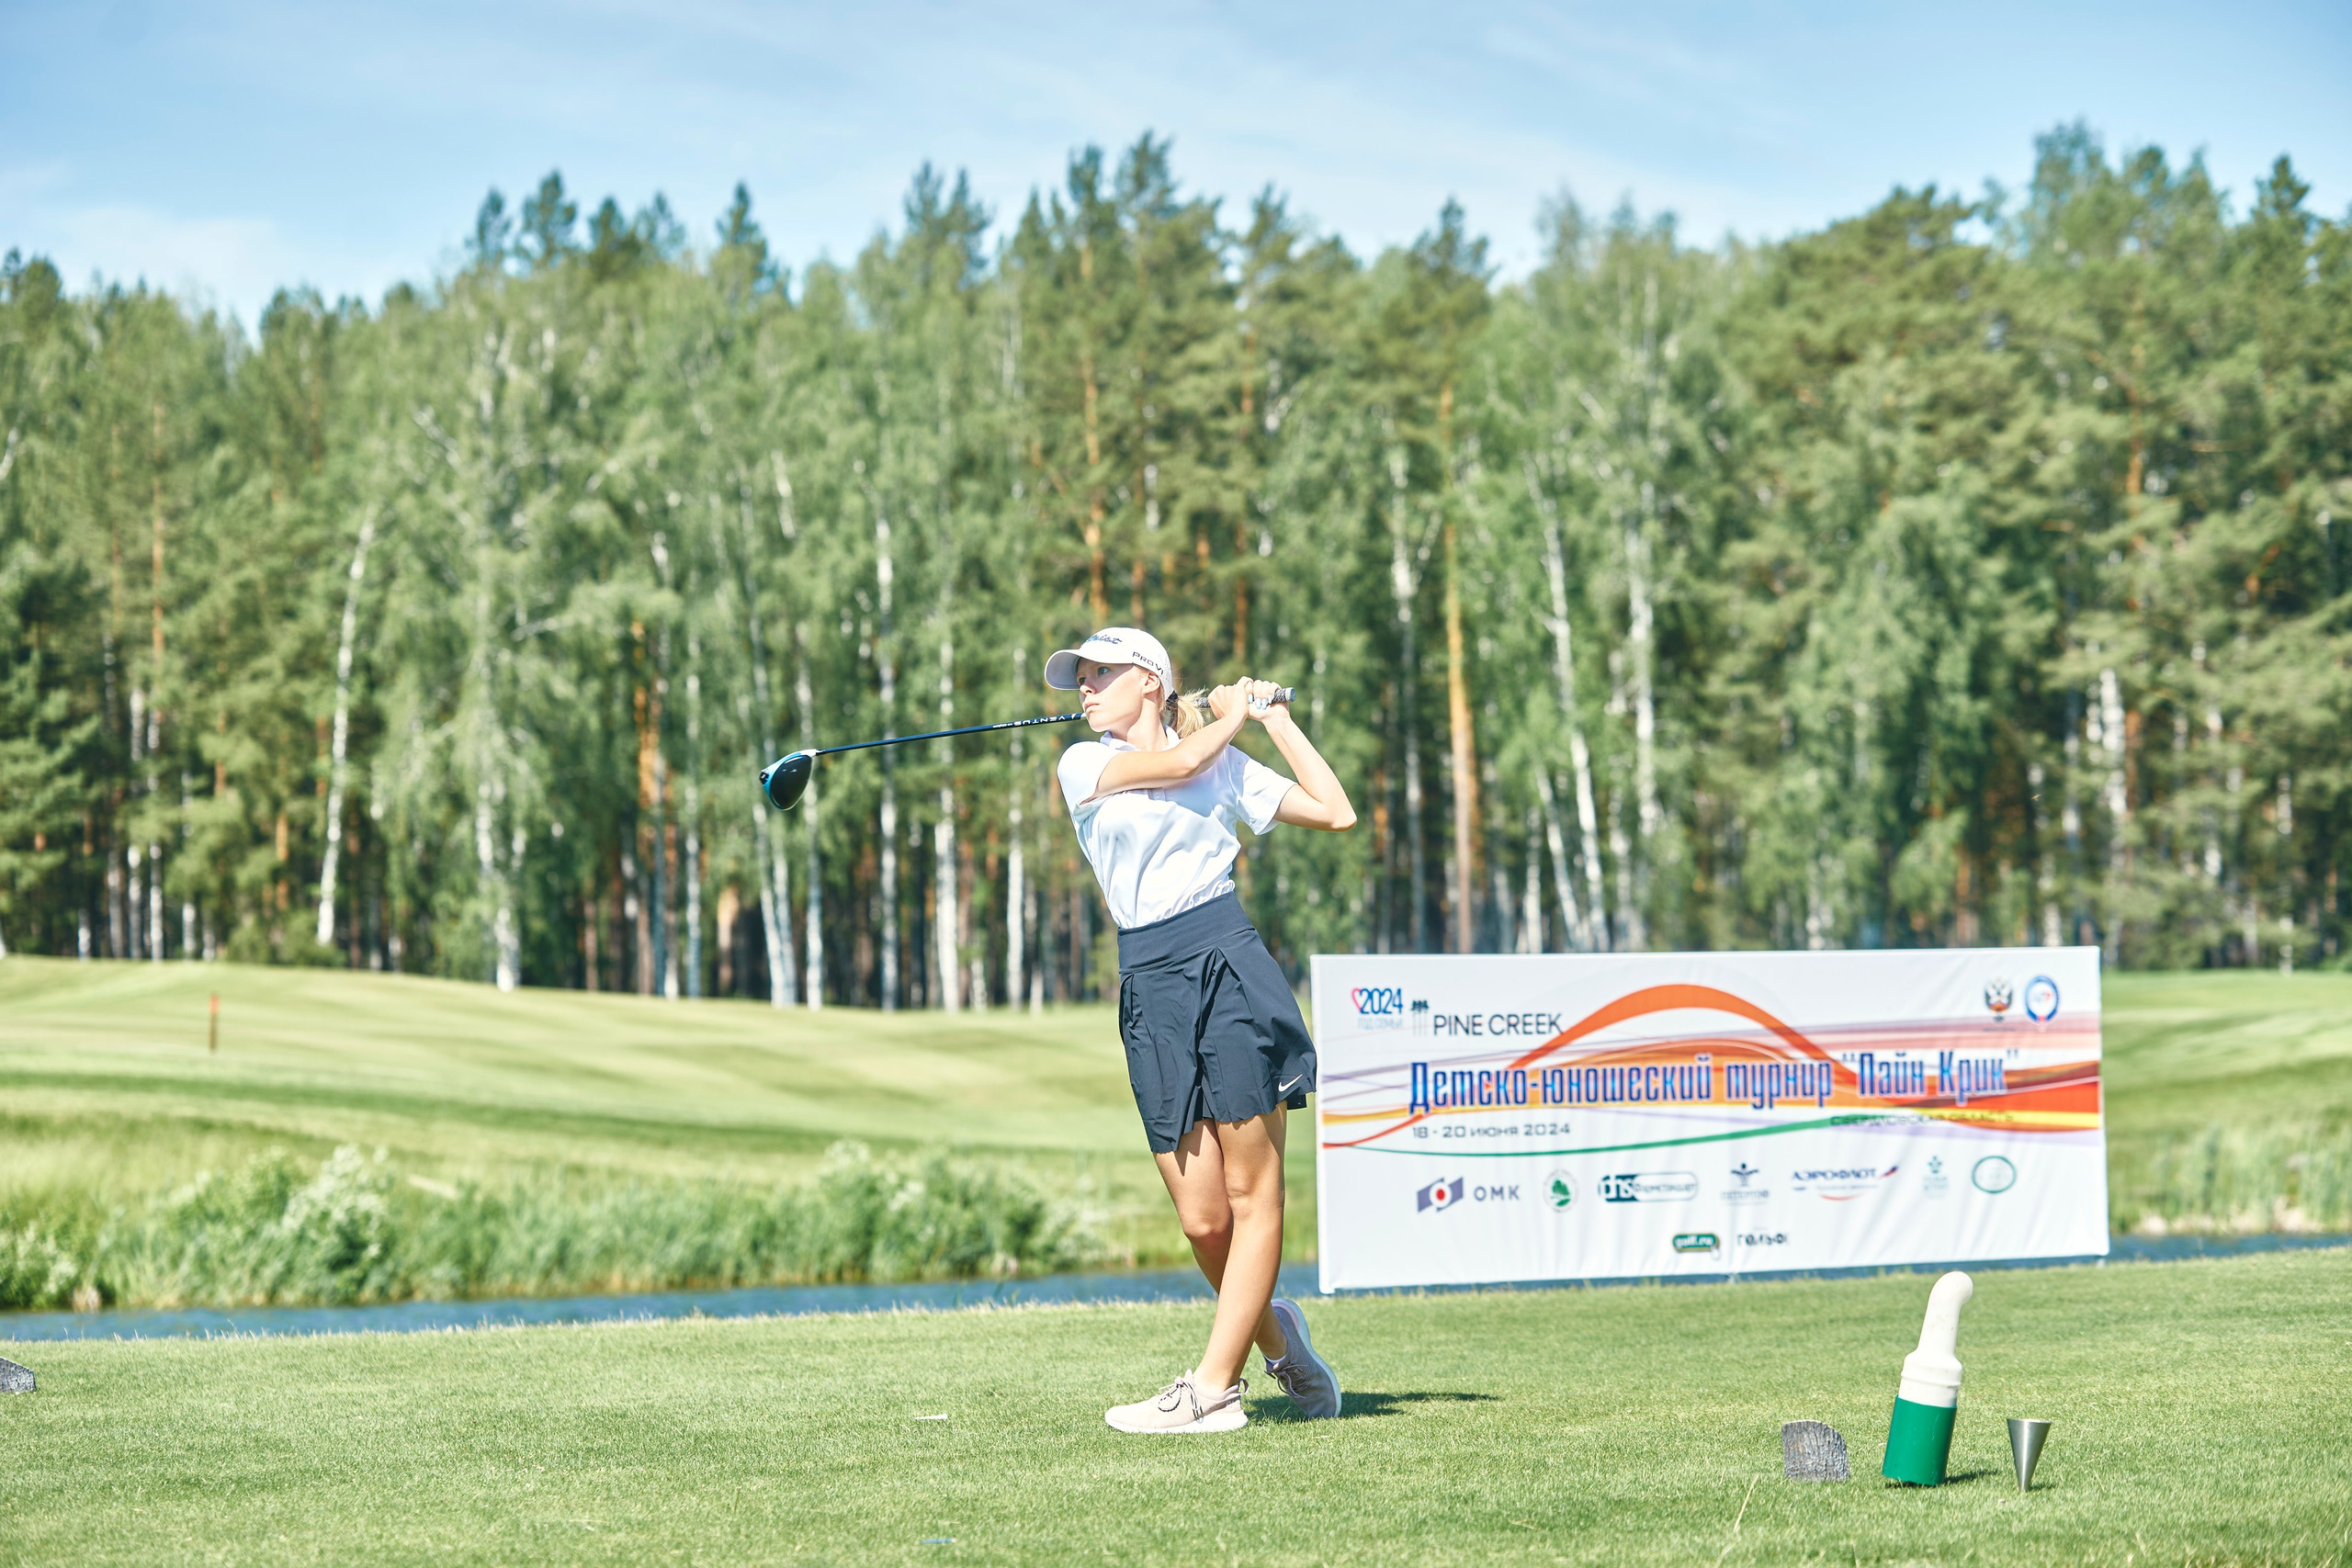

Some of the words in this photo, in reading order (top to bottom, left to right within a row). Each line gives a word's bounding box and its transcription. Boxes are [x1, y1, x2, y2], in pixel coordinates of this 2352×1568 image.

[1132, 651, 1154, 667] PRO
[1013, 716, 1066, 727] VENTUS
[1360, 987, 1404, 1014] 2024
[1434, 1014, 1483, 1035] PINE
[1488, 1013, 1564, 1035] CREEK
[1409, 1055, 1712, 1115] Детско-юношеский
[1725, 1062, 1832, 1110] турнир
[1412, 1126, 1429, 1139] 18
[1442, 1125, 1466, 1138] 20
[1523, 1122, 1570, 1136] 2024
